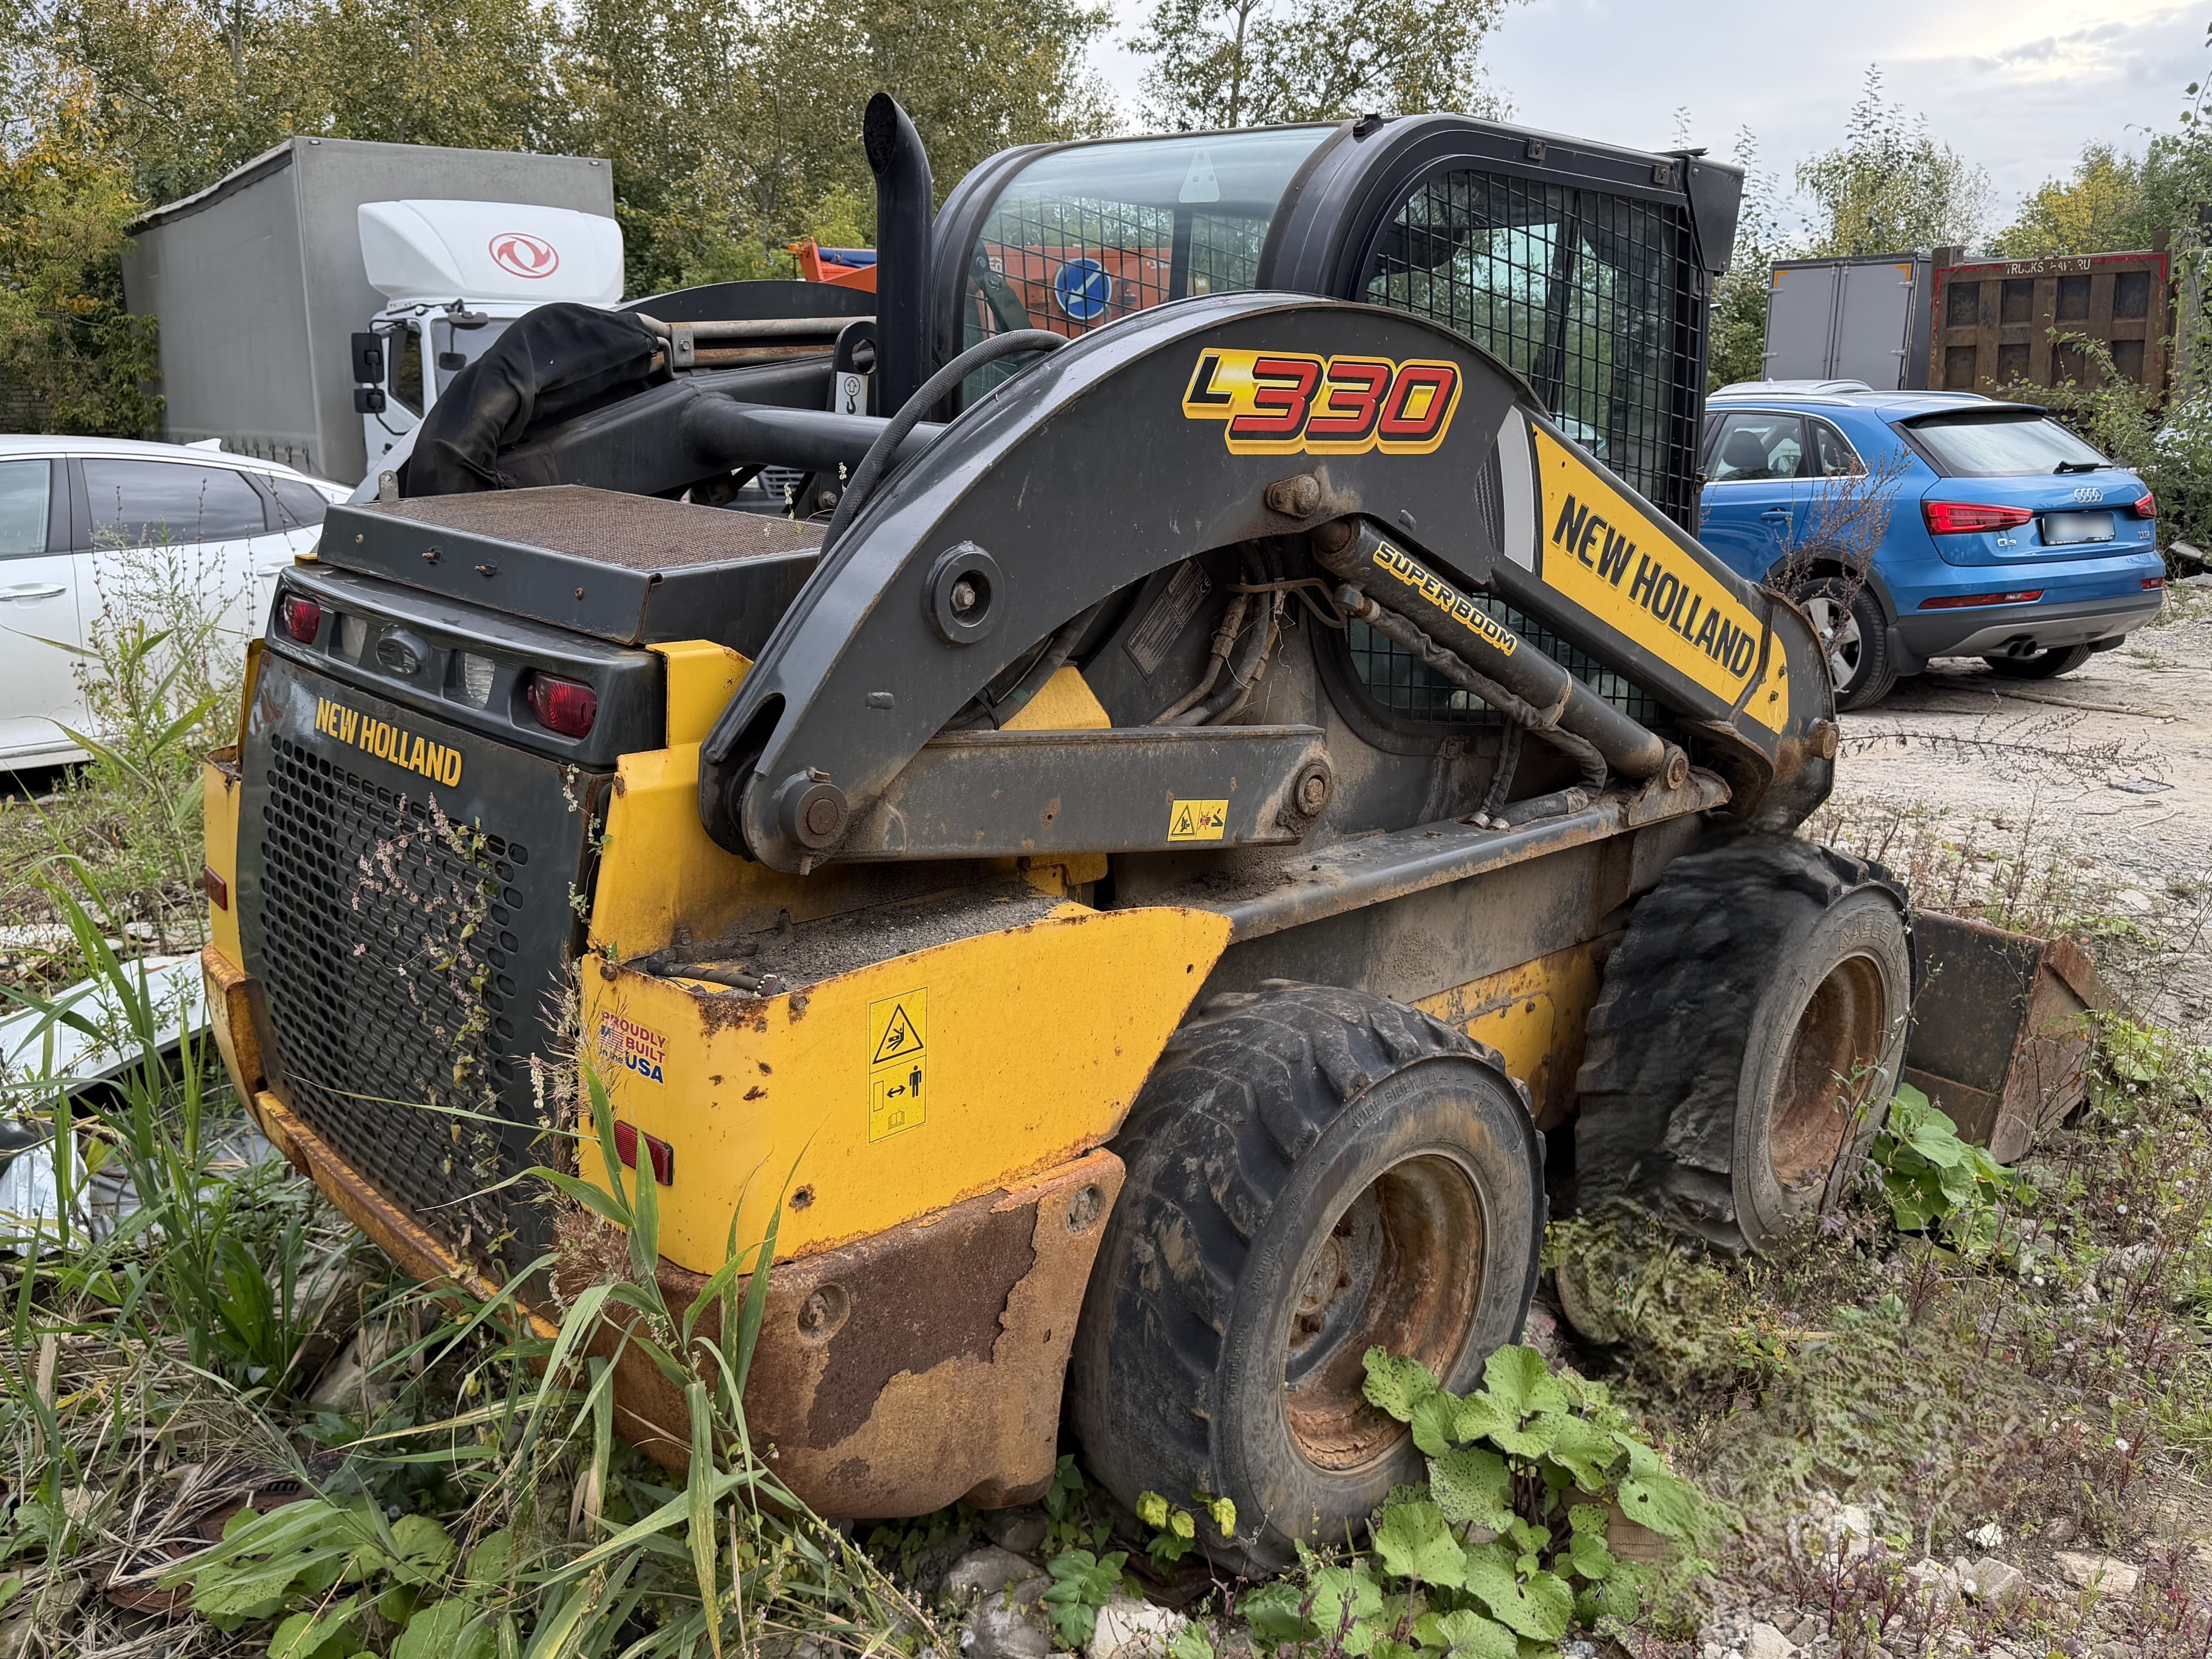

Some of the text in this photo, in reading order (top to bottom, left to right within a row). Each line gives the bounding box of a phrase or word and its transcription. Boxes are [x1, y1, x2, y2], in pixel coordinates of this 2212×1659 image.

[1183, 349, 1461, 450] L330
[1997, 537, 2016, 547] Q3
[1373, 541, 1518, 656] SUPER BOOM
[1551, 493, 1756, 680] NEW HOLLAND
[315, 696, 461, 787] NEW HOLLAND
[601, 1009, 666, 1048] PROUDLY
[625, 1051, 664, 1084] USA
[626, 1036, 666, 1063] BUILT
[1384, 1073, 1441, 1103] SIDEWALL
[1252, 1248, 1274, 1291] NYLON
